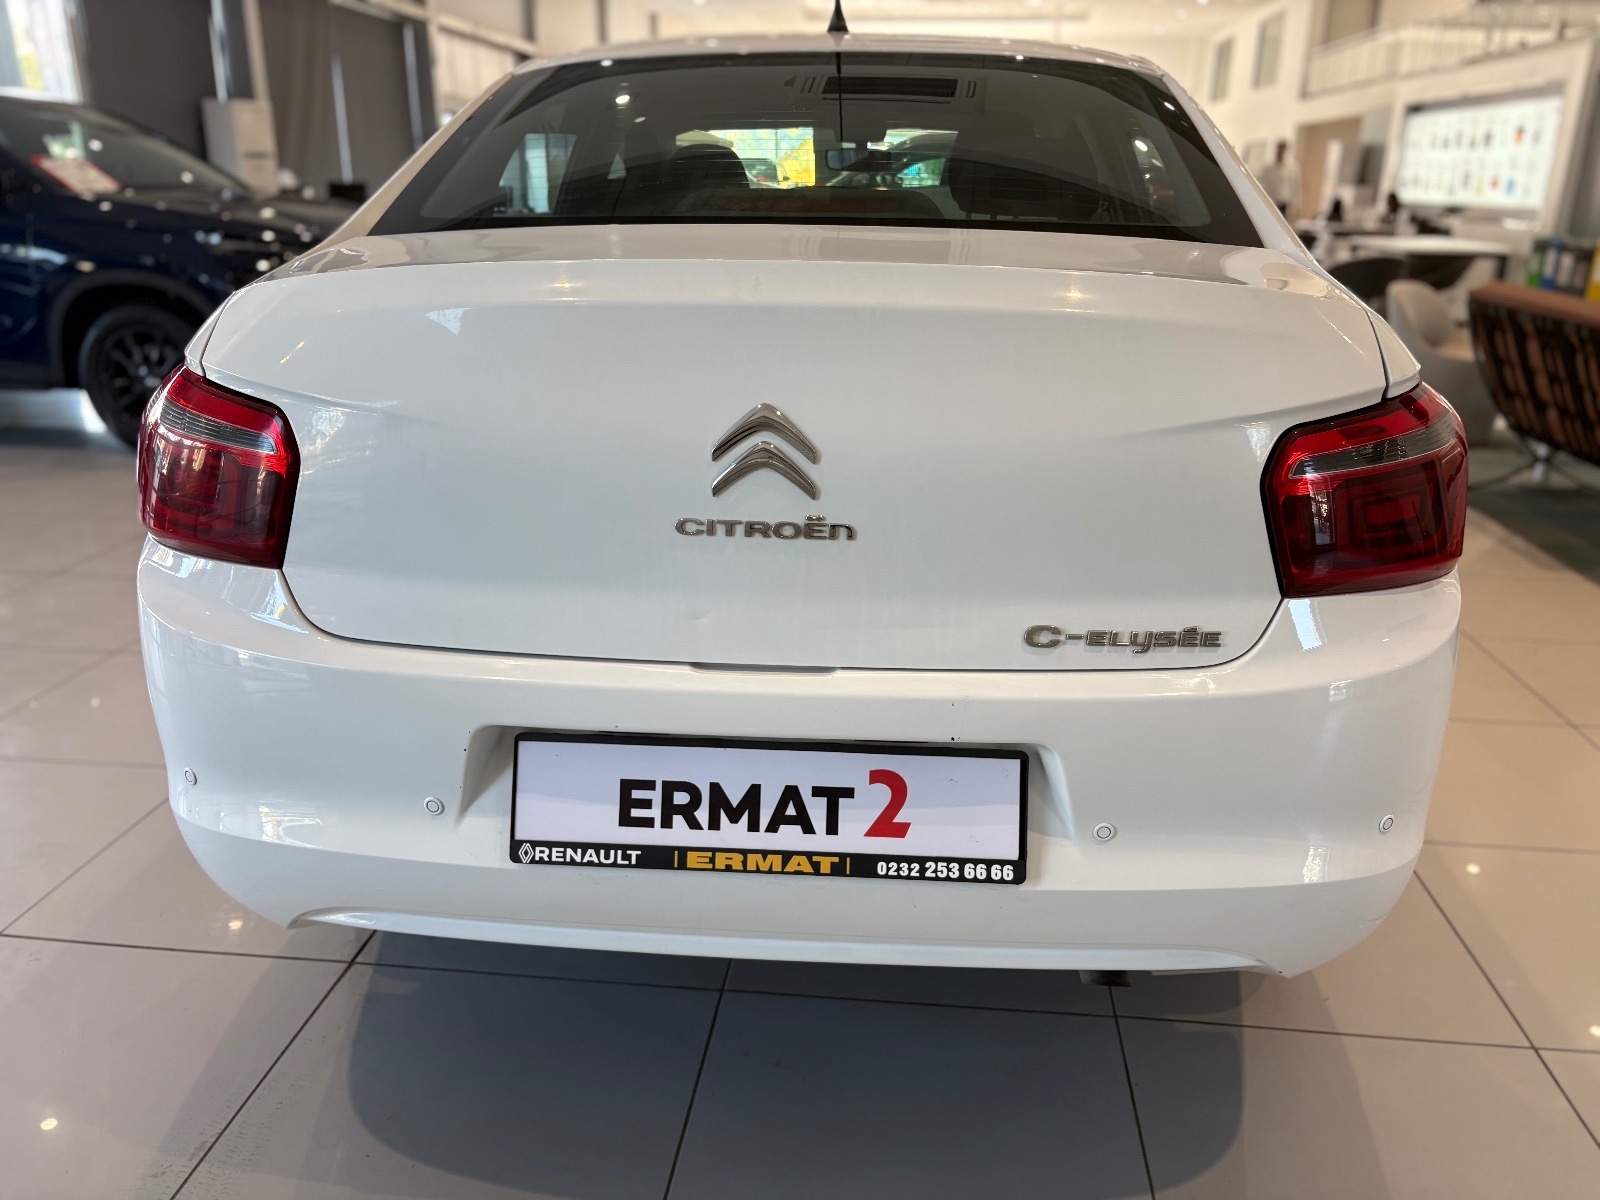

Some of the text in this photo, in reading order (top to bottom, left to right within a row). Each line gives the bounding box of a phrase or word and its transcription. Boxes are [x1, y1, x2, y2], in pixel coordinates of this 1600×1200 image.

[618, 769, 912, 838] ERMAT 2
[534, 846, 1014, 881] RENAULT ERMAT 0232 253 66 66
